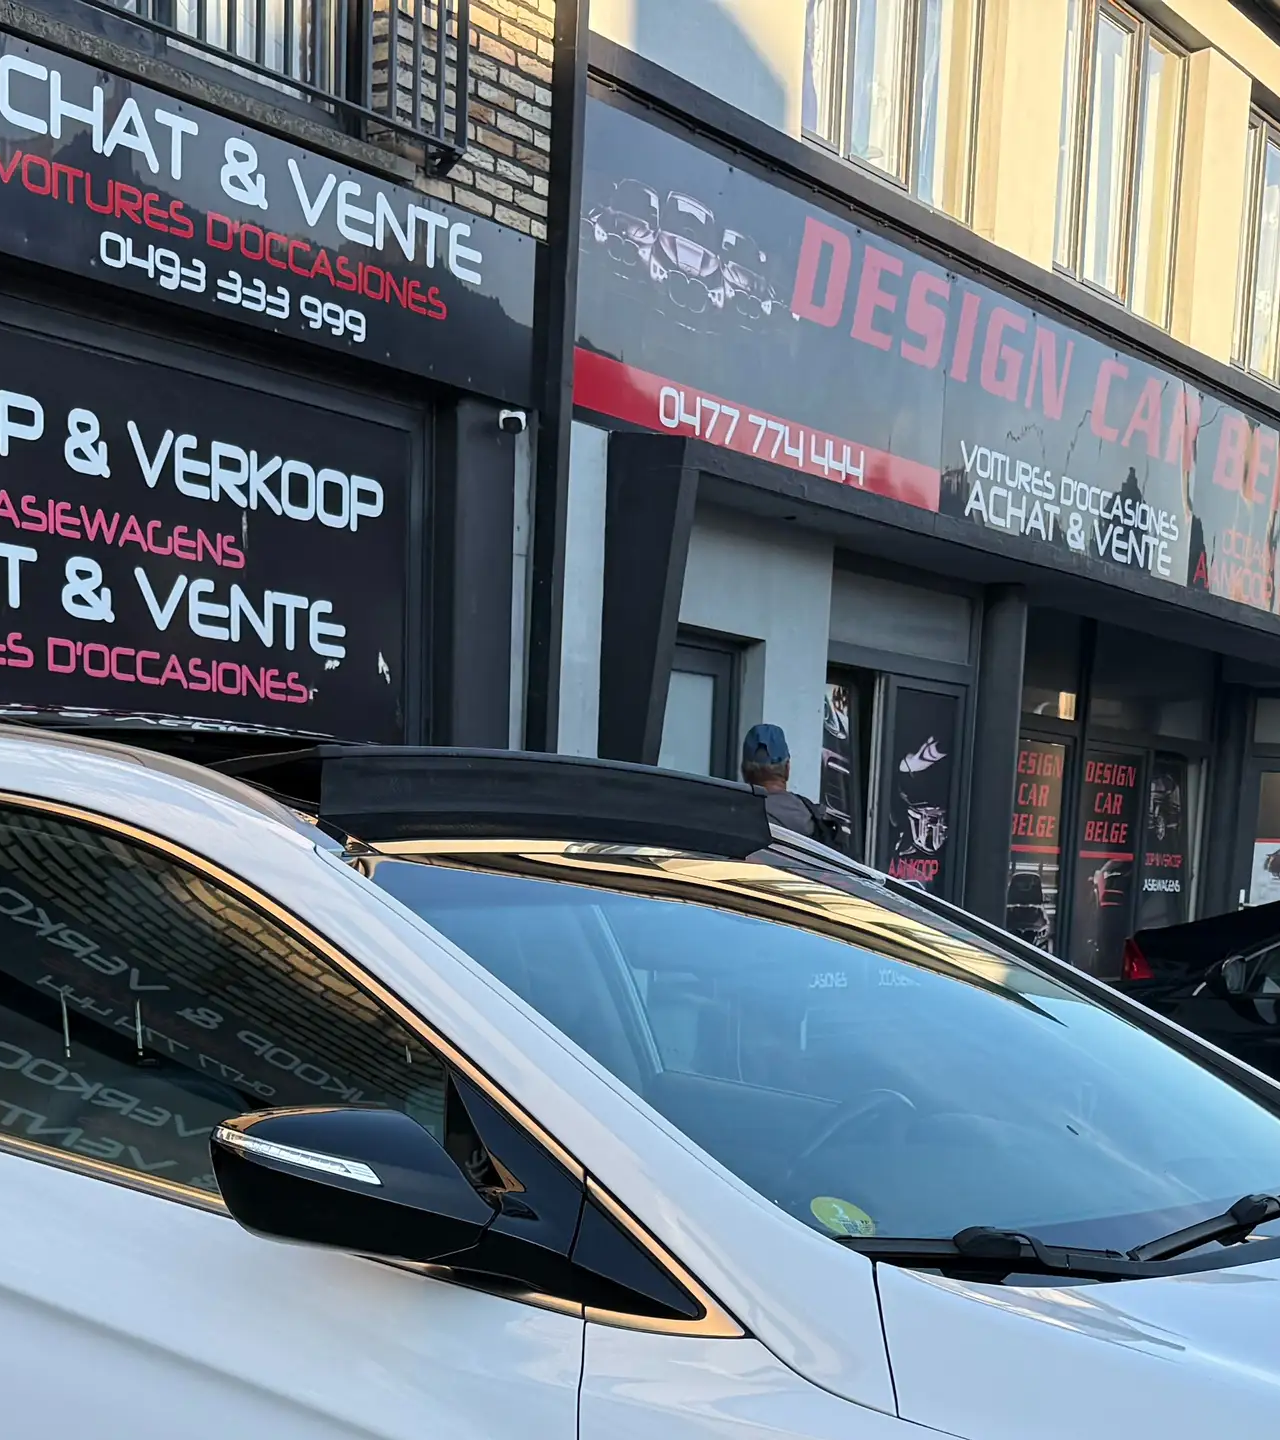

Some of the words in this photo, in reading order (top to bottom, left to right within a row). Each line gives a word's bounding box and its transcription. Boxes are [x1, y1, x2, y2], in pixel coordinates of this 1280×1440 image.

[221, 137, 268, 210] &
[288, 158, 483, 286] VENTE
[99, 231, 207, 293] 0493
[217, 270, 290, 321] 333
[300, 295, 367, 344] 999
[206, 212, 448, 321] D'OCCASIONES
[791, 215, 1075, 421] DESIGN
[1090, 357, 1202, 472] CAR
[64, 408, 110, 479] &
[127, 420, 384, 532] VERKOOP
[658, 386, 739, 446] 0477
[748, 414, 803, 468] 774
[811, 433, 864, 486] 444
[960, 440, 1056, 501] VOITURES
[1060, 476, 1180, 542] D'OCCASIONES
[964, 480, 1061, 544] ACHAT
[1066, 513, 1086, 552] &
[1095, 524, 1173, 577] VENTE
[61, 557, 115, 624] &
[134, 567, 347, 660] VENTE
[47, 637, 310, 706] D'OCCASIONES
[1017, 783, 1050, 807] CAR
[1085, 761, 1137, 788] DESIGN
[1094, 792, 1124, 815] CAR
[1084, 821, 1129, 844] BELGE
